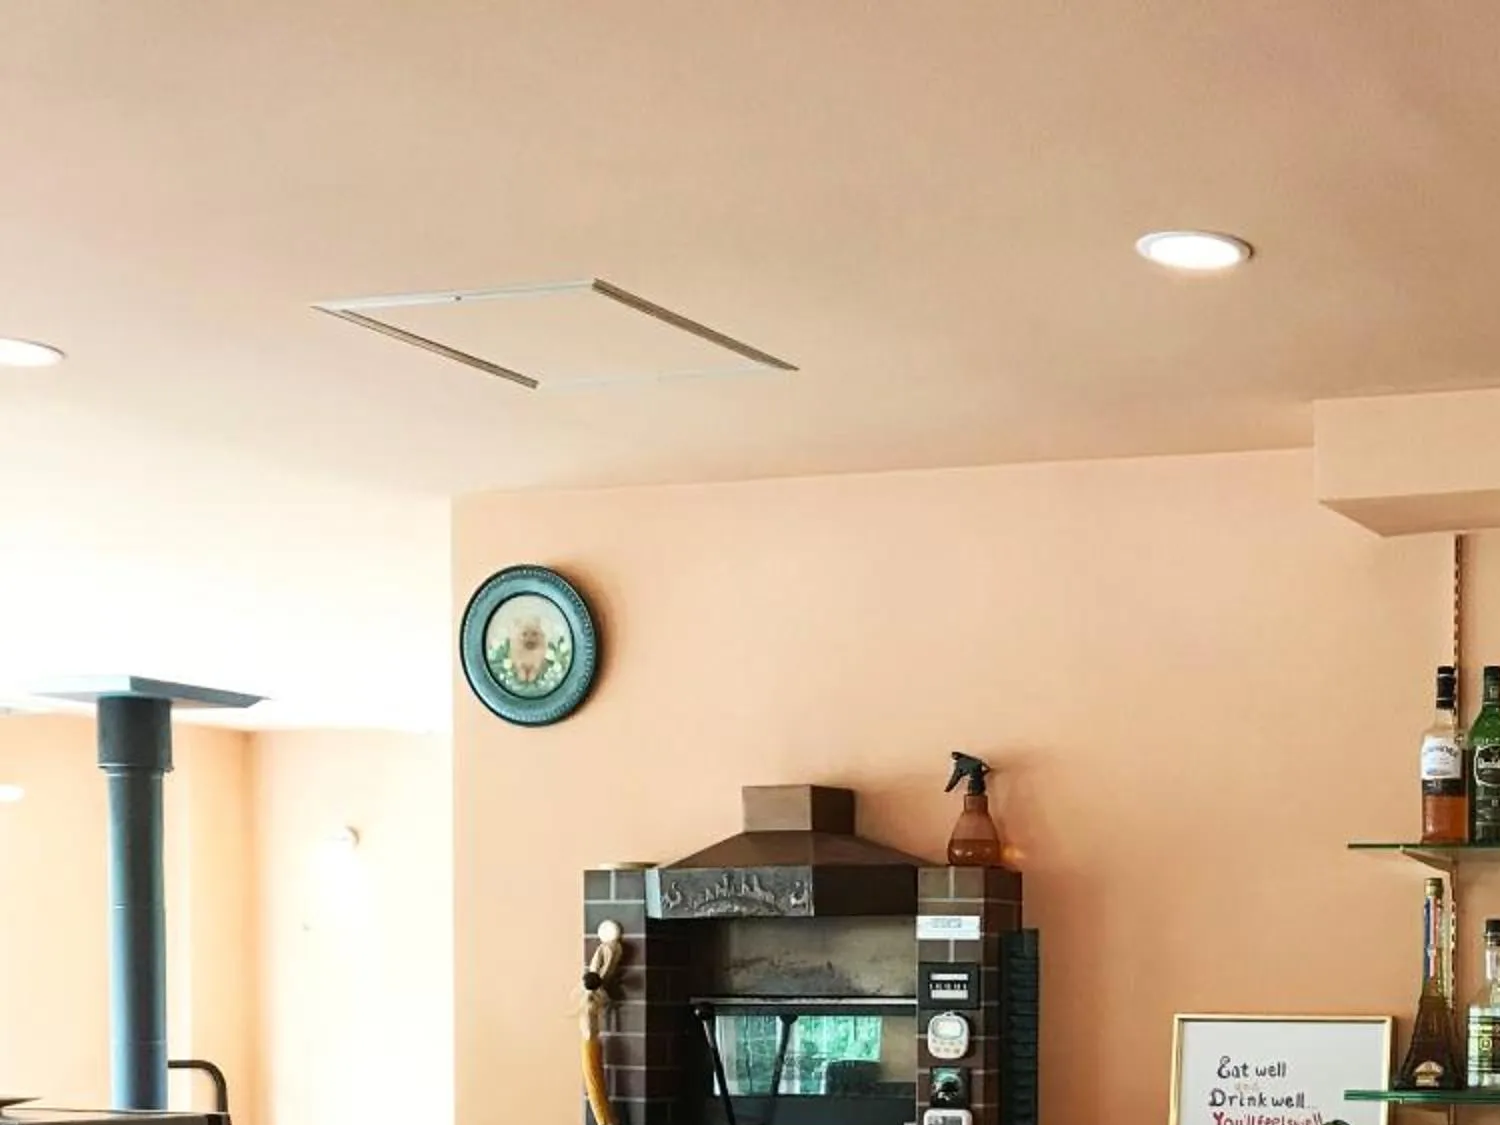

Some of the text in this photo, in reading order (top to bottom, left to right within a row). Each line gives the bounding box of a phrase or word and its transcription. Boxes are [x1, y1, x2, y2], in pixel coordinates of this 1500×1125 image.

[1217, 1055, 1287, 1079] Eat well
[1208, 1088, 1267, 1107] Drink
